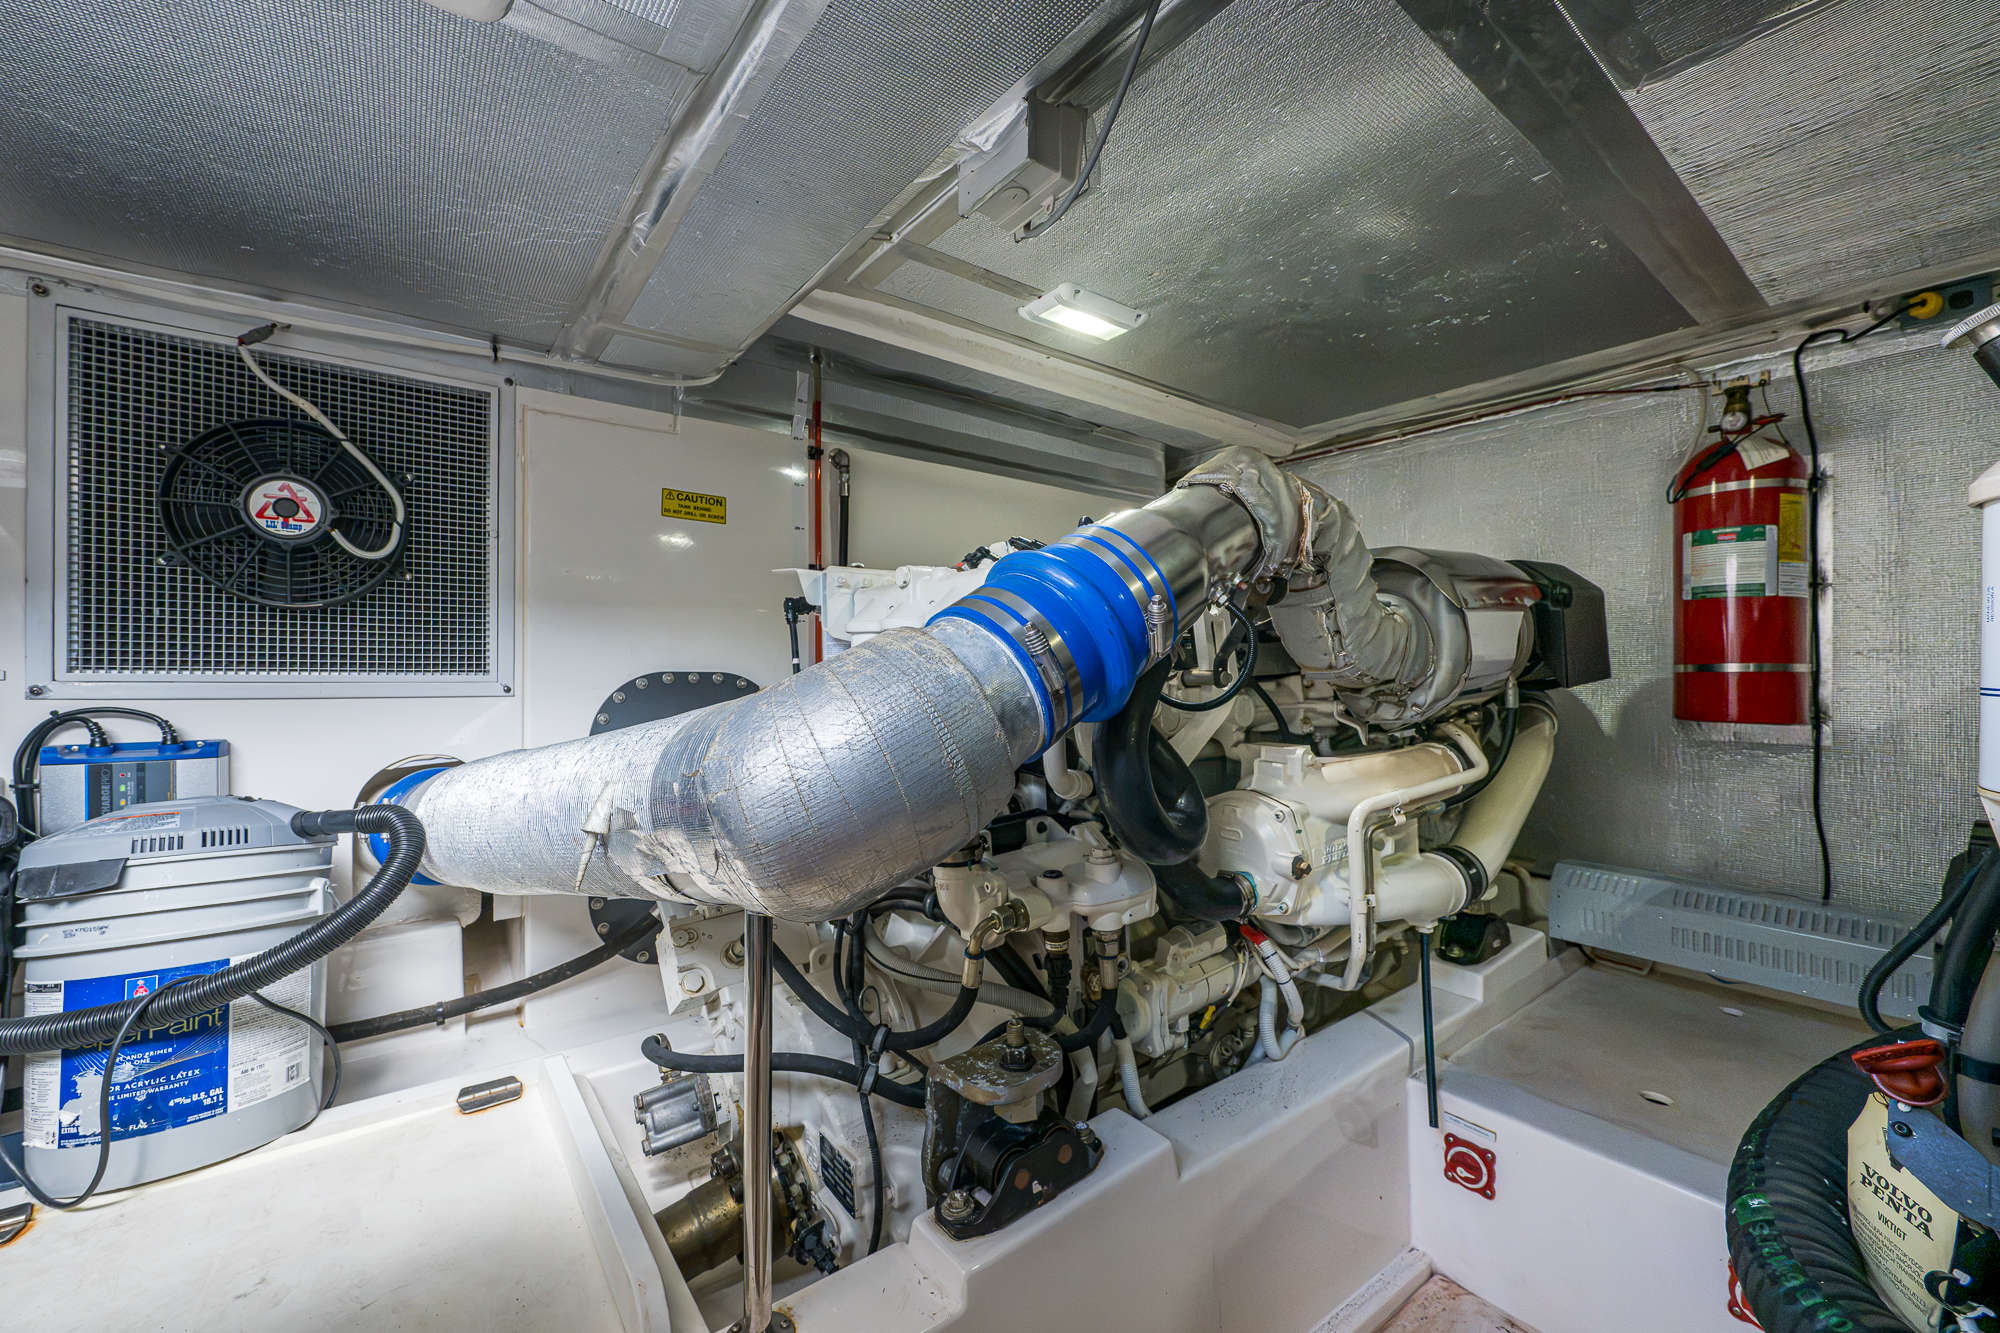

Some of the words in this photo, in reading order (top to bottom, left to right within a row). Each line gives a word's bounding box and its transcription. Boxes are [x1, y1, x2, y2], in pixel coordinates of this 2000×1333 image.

[676, 492, 723, 507] CAUTION
[693, 505, 712, 513] BEHIND
[101, 766, 111, 815] HARGEPRO
[126, 1053, 143, 1061] AND
[144, 1047, 173, 1058] PRIMER
[134, 1057, 151, 1065] ONE
[124, 1076, 167, 1090] ACRYLIC
[170, 1068, 201, 1081] LATEX
[117, 1089, 146, 1100] LIMITED
[147, 1080, 190, 1094] WARRANTY
[192, 1091, 208, 1102] U.S.
[209, 1086, 225, 1097] GAL
[202, 1096, 217, 1106] 18.1
[218, 1094, 224, 1102] L
[61, 1126, 78, 1134] EXTRA
[1862, 1161, 1933, 1224] VOLVO
[1859, 1172, 1934, 1242] PENTA
[1877, 1210, 1908, 1242] VIKTIGT
